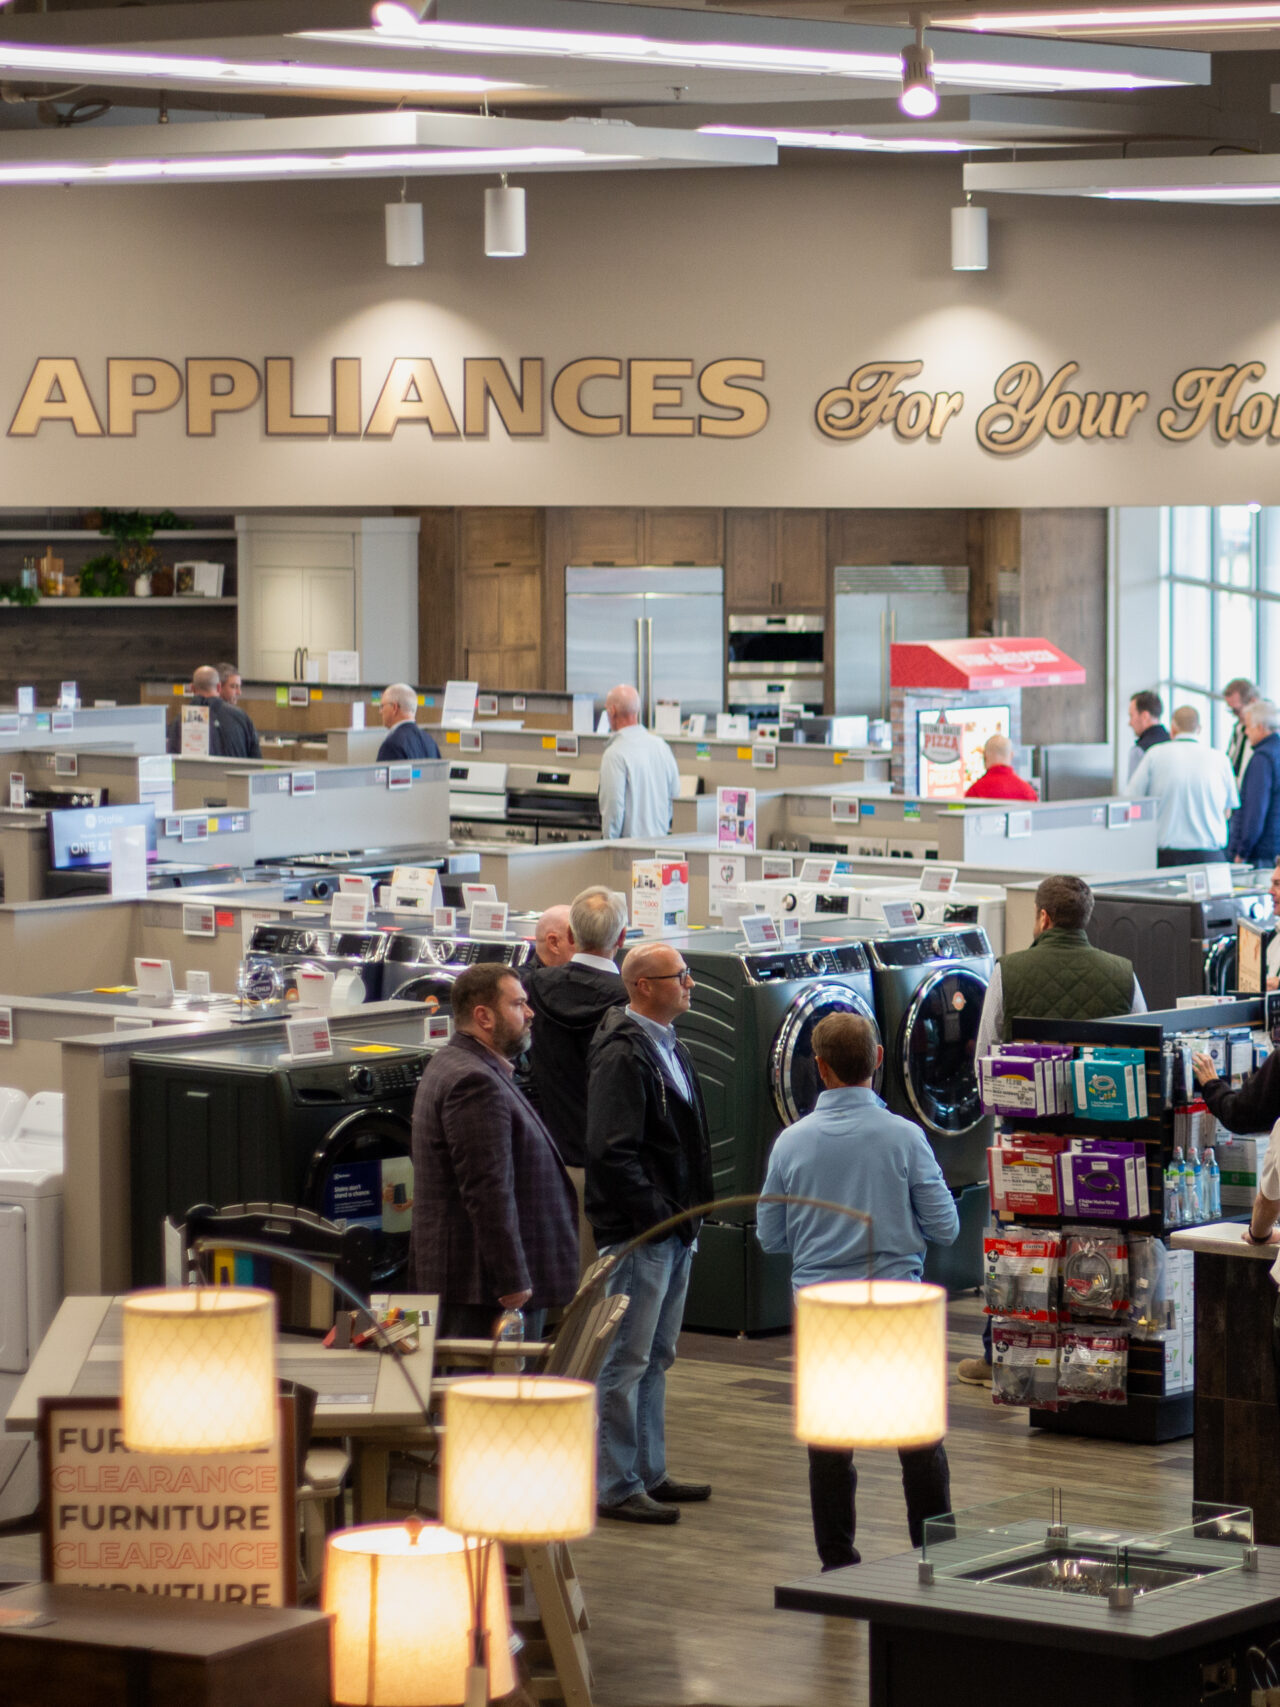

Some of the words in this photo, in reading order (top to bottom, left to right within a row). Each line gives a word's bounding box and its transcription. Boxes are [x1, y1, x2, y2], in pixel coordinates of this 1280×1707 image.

[6, 356, 769, 438] APPLIANCES
[815, 360, 962, 440] For
[976, 361, 1148, 455] Your
[923, 735, 959, 750] PIZZA
[70, 841, 96, 855] ONE
[52, 1466, 278, 1494] CLEARANCE
[58, 1504, 271, 1531] FURNITURE
[53, 1542, 279, 1570] CLEARANCE
